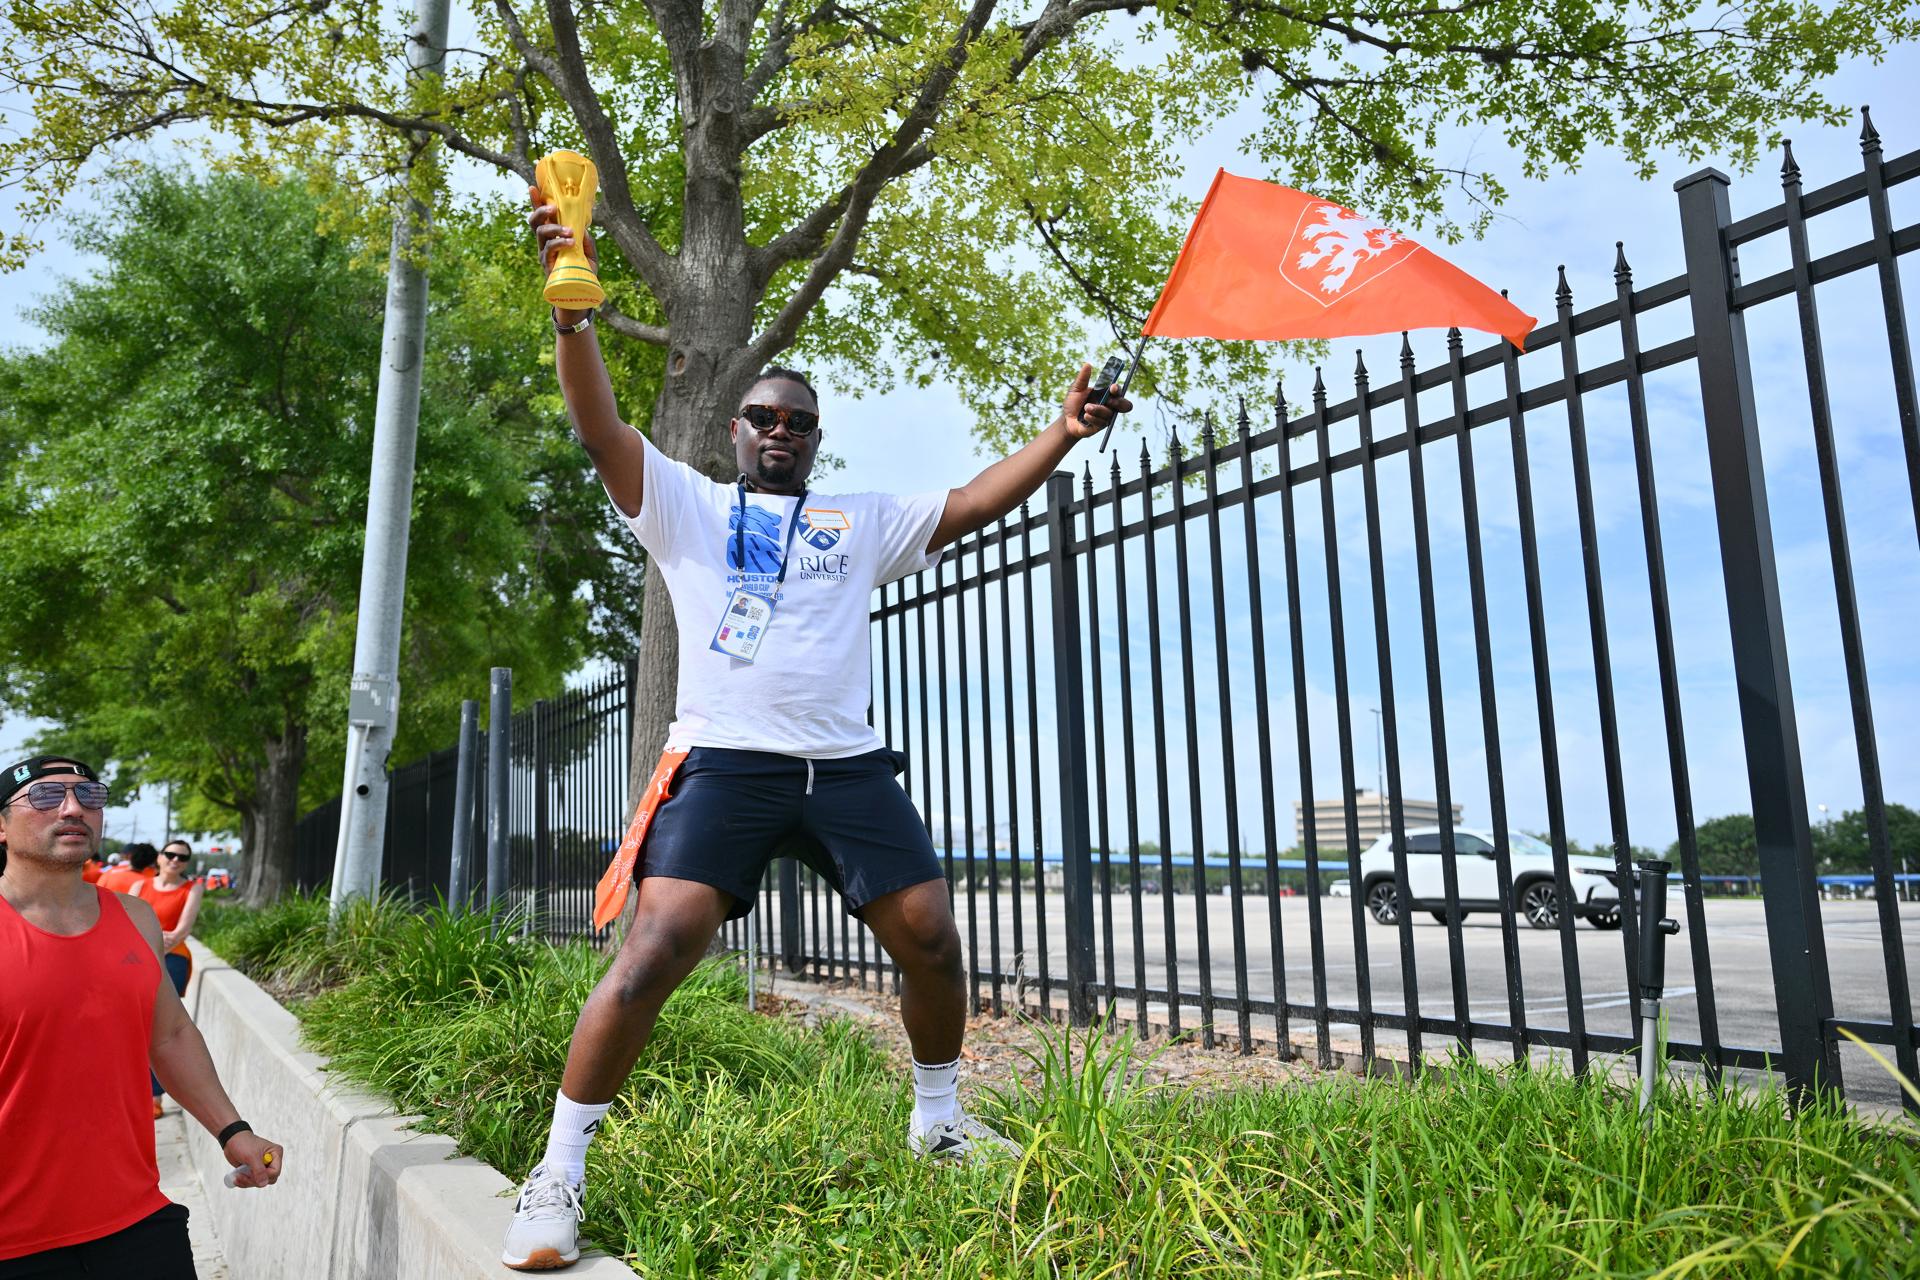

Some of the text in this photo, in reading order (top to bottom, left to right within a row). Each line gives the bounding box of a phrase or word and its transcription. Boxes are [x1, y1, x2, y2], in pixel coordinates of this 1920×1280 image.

[800, 554, 849, 575] RICE
[727, 575, 779, 583] HOUSTO
[800, 572, 846, 583] UNIVERSITY
